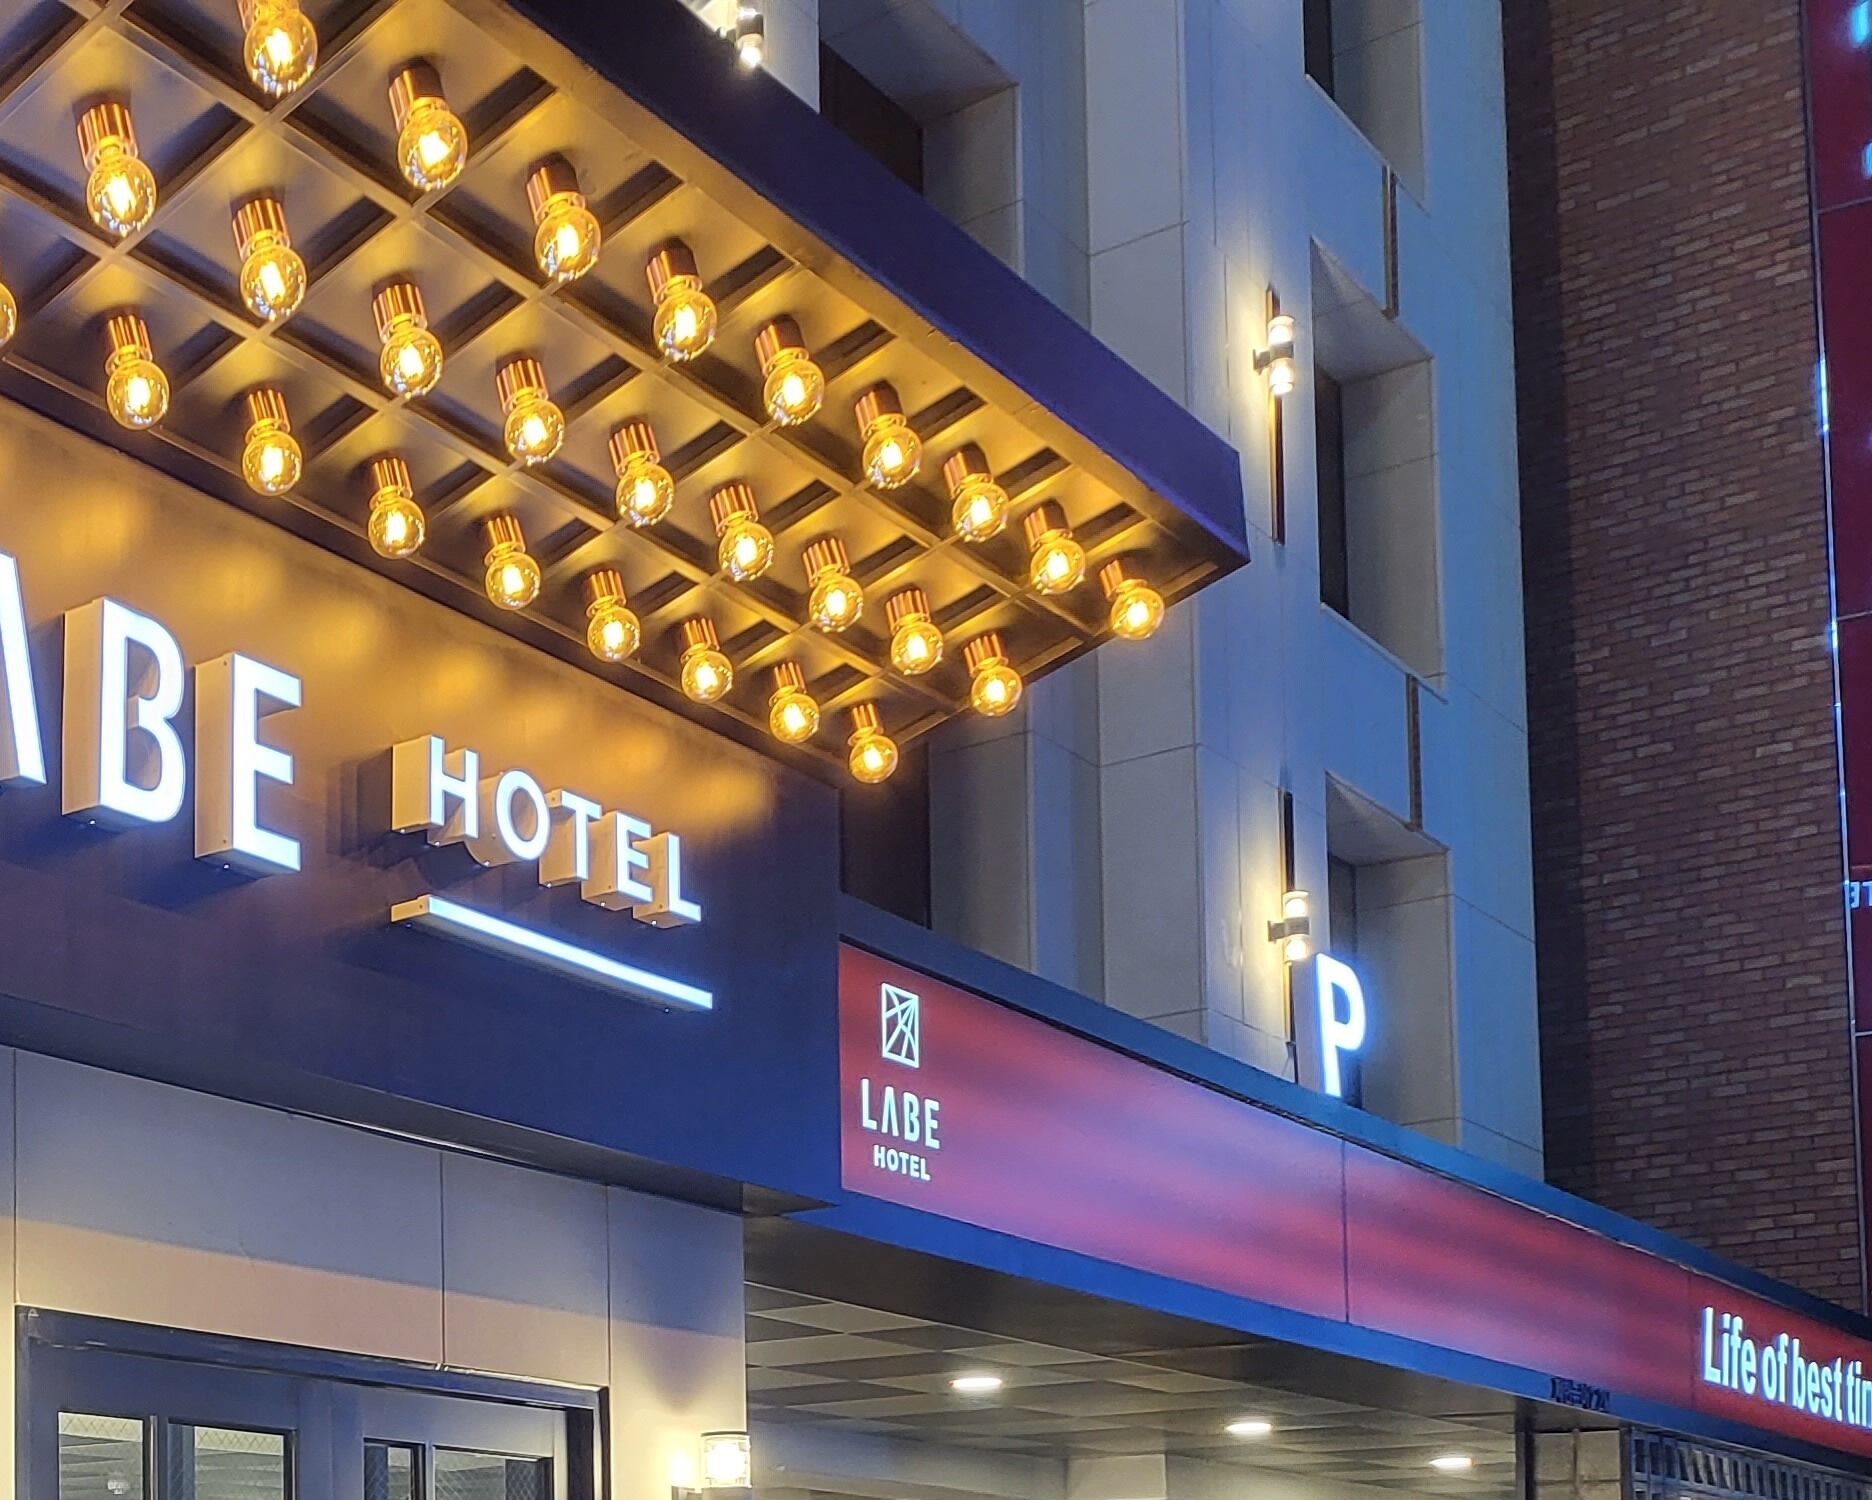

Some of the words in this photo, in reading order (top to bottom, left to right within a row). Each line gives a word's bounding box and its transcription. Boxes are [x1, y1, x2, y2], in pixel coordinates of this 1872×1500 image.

[430, 735, 701, 922] HOTEL
[1316, 953, 1366, 1097] P
[861, 1077, 940, 1149] LABE
[873, 1144, 931, 1181] HOTEL
[1703, 1306, 1757, 1395] Life
[1762, 1332, 1789, 1403] of
[1792, 1337, 1843, 1412] best
